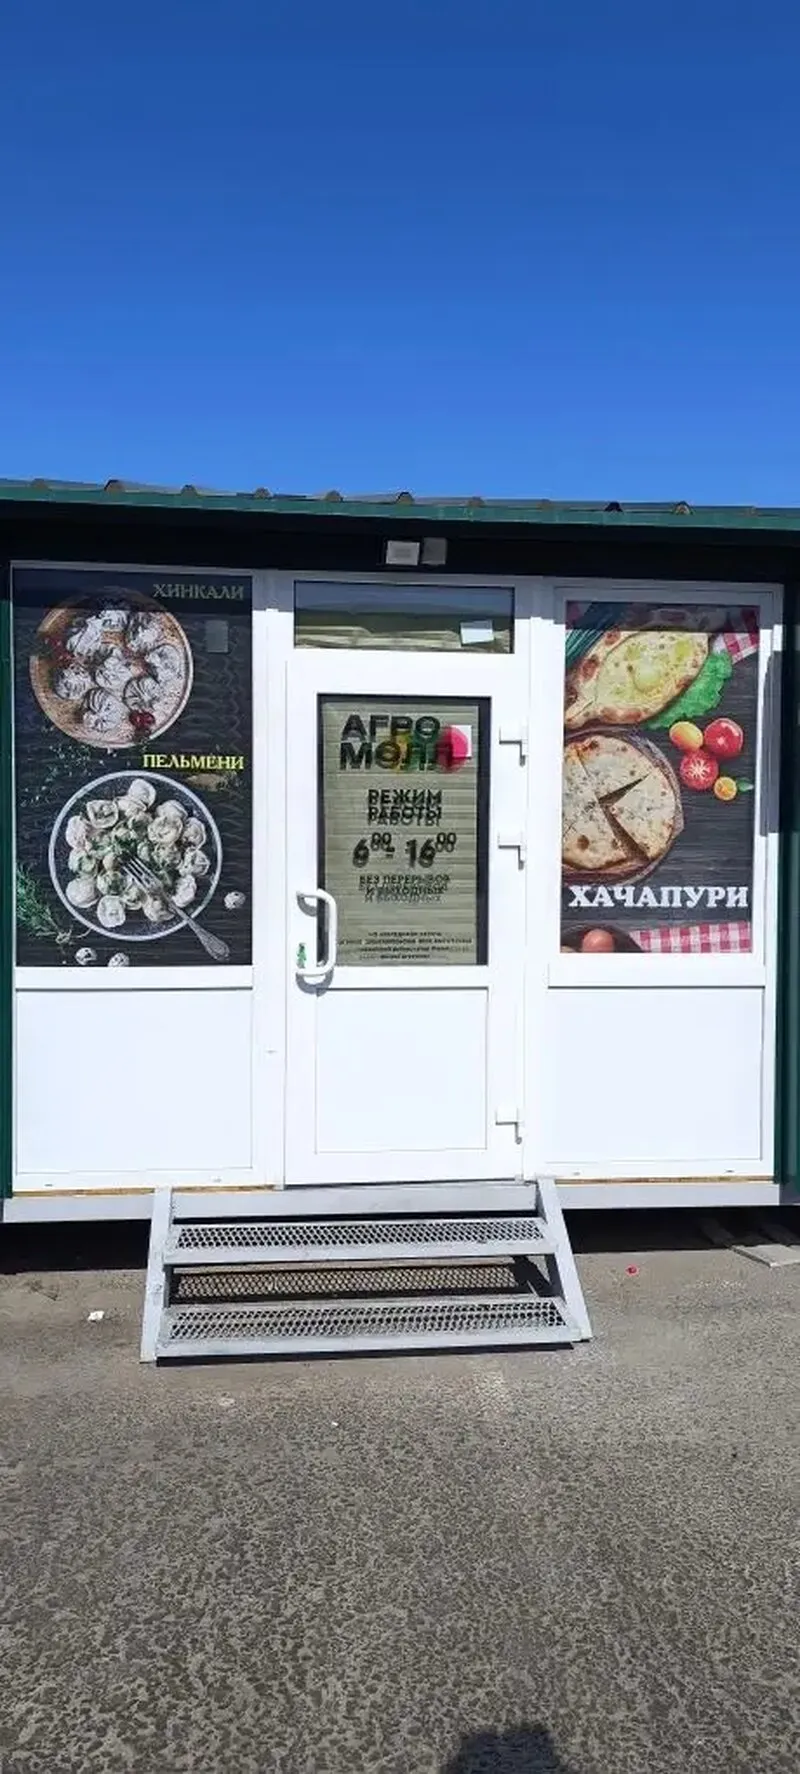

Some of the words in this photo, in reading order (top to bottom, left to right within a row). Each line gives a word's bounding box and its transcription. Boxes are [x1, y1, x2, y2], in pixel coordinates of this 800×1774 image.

[153, 583, 244, 600] ХИНКАЛИ
[342, 714, 441, 741] АГРО
[143, 754, 245, 770] ПЕЛЬМЕНИ
[340, 742, 454, 770] МОЛЛ
[368, 789, 442, 804] РЕЖИМ
[368, 805, 442, 823] РАБОТЫ
[568, 884, 749, 907] ХАЧАПУРИ
